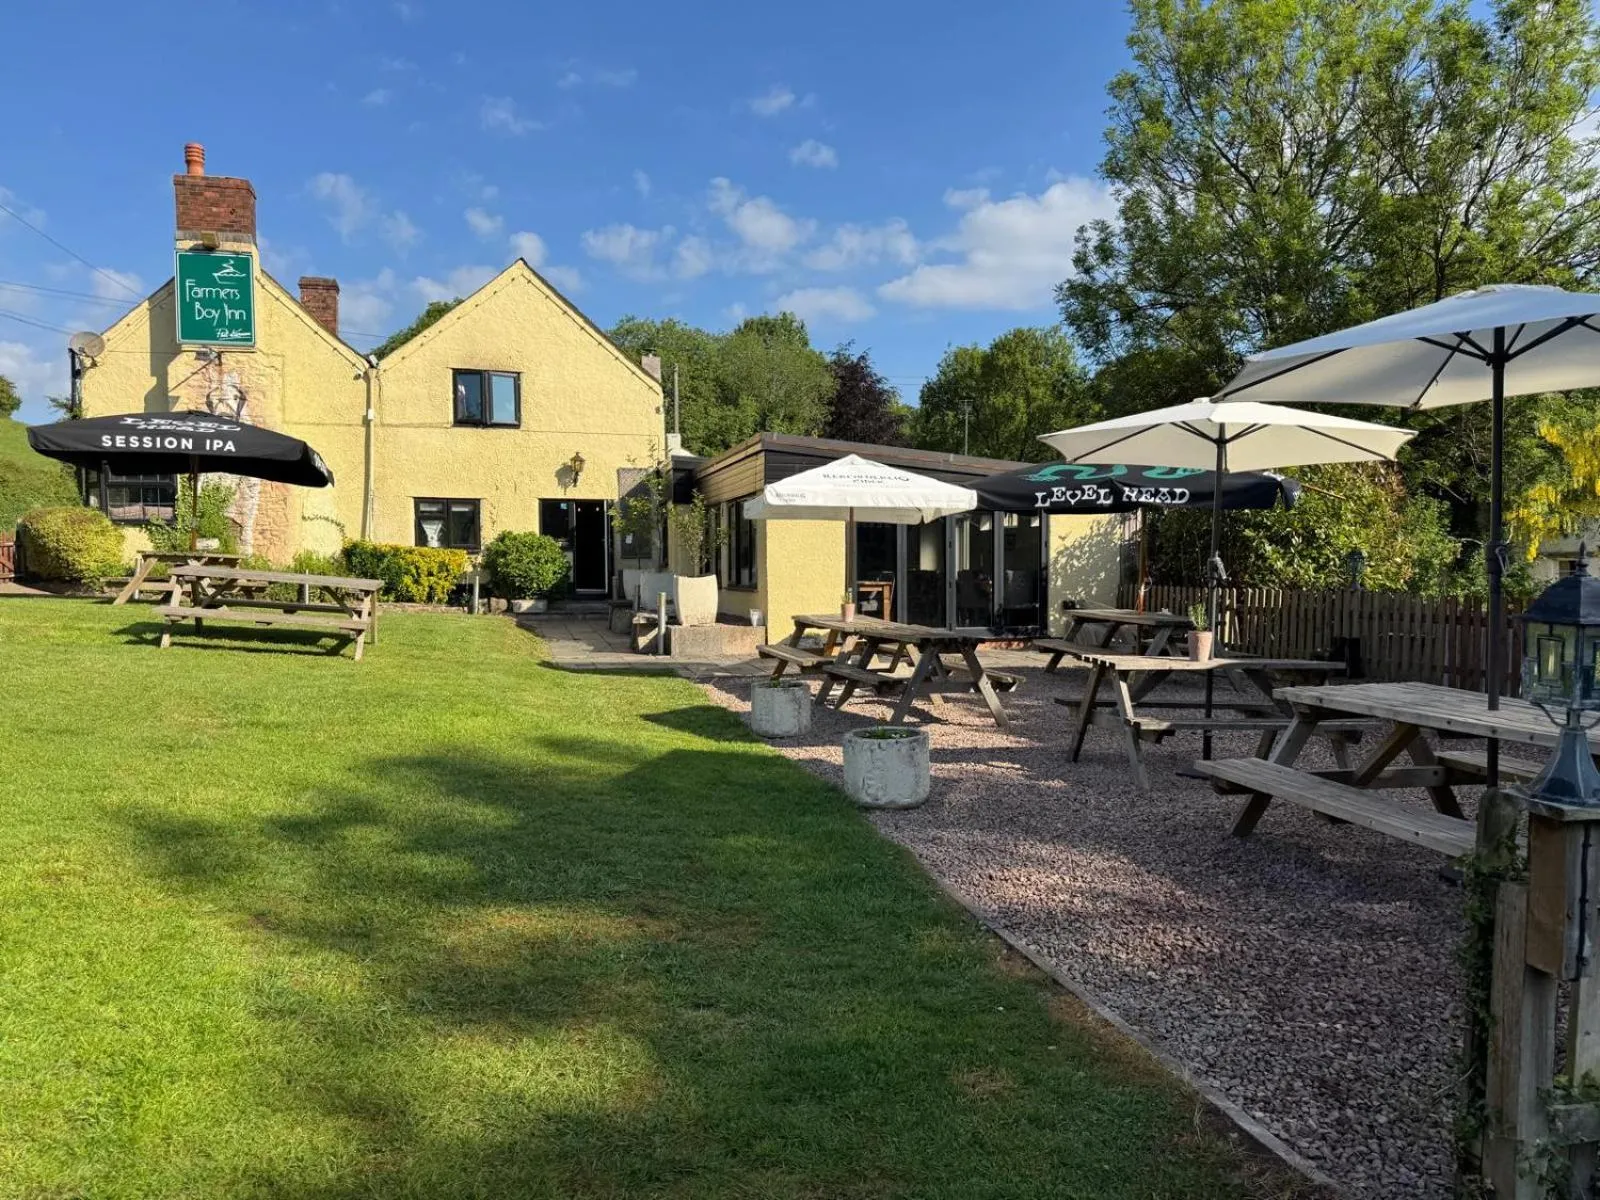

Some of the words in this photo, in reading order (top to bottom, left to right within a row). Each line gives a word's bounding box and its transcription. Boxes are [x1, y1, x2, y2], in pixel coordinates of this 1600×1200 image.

[185, 279, 241, 302] Farmers
[195, 301, 221, 327] Boy
[223, 302, 246, 326] Inn
[101, 435, 193, 450] SESSION
[205, 439, 237, 452] IPA
[1034, 484, 1113, 508] LEVEL
[1122, 487, 1191, 504] HEAD
